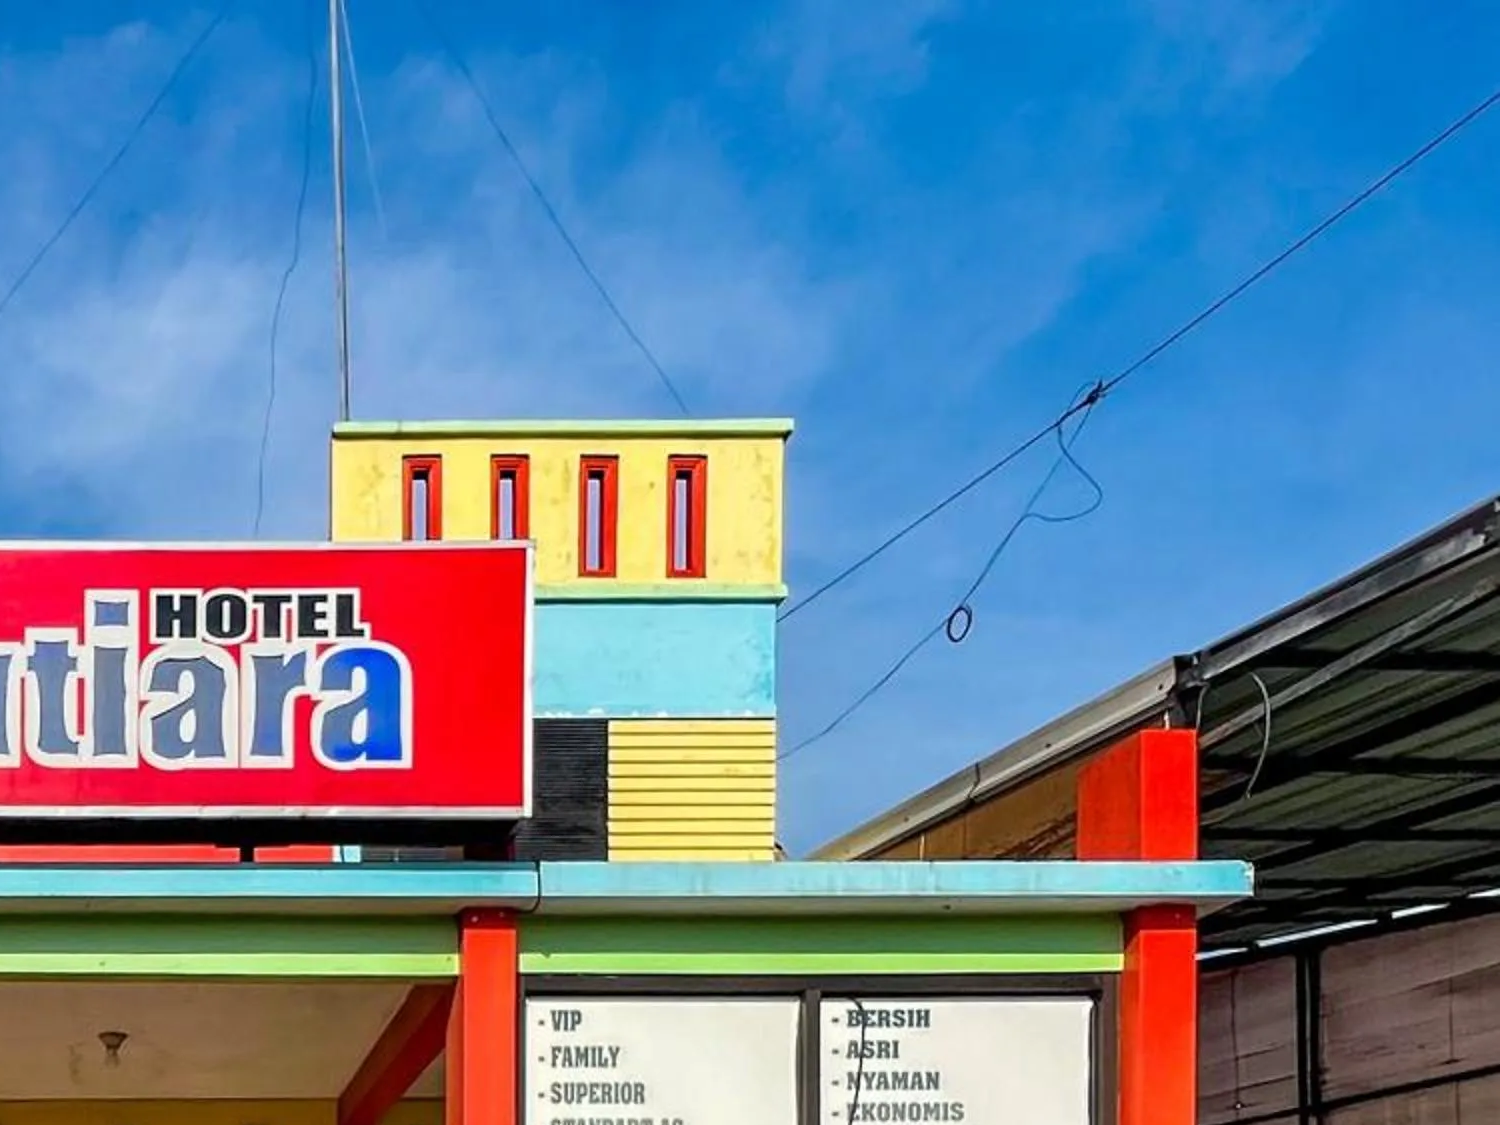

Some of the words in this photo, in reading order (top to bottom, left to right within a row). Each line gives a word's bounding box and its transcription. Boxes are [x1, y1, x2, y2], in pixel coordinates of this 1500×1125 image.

[154, 593, 366, 639] HOTEL
[550, 1009, 583, 1032] VIP
[846, 1009, 931, 1028] BERSIH
[550, 1046, 621, 1069] FAMILY
[846, 1040, 900, 1060] ASRI
[846, 1071, 941, 1091] NYAMAN
[550, 1082, 646, 1105] SUPERIOR
[847, 1102, 965, 1122] EKONOMIS
